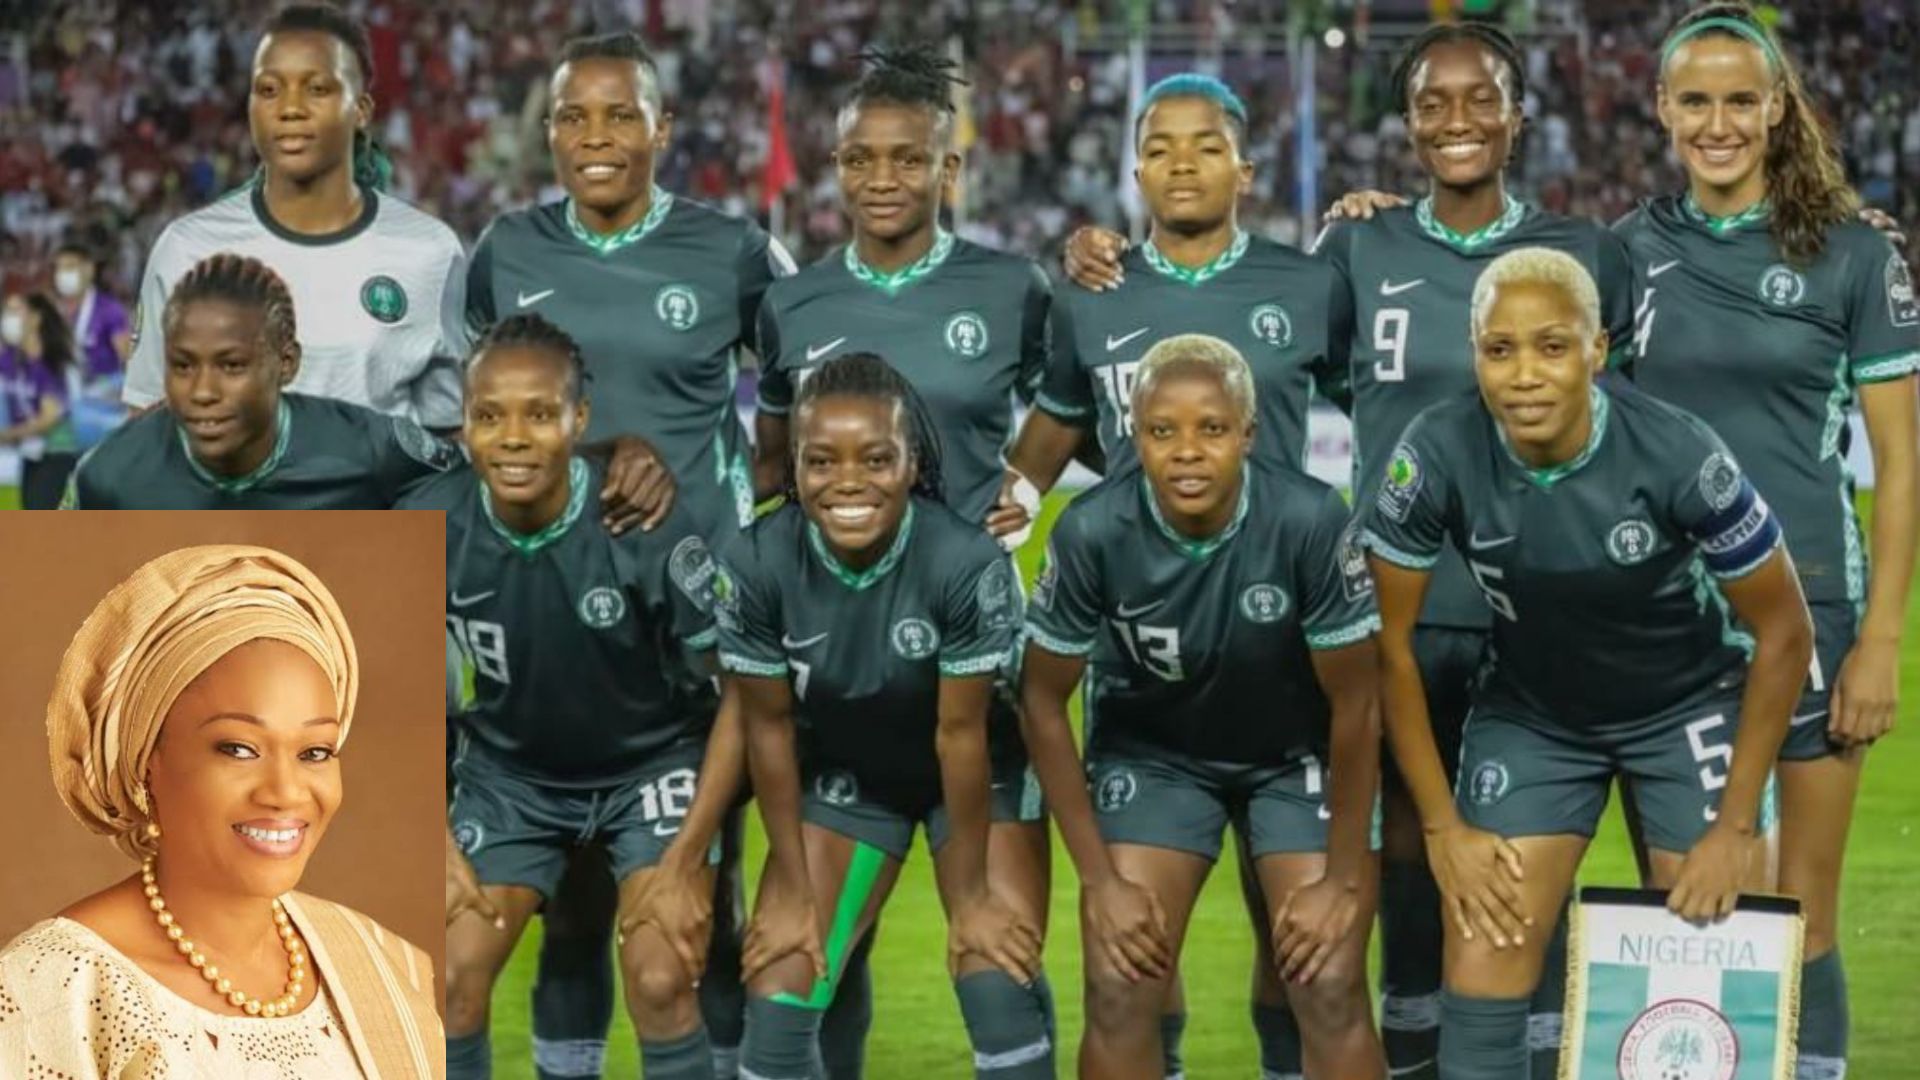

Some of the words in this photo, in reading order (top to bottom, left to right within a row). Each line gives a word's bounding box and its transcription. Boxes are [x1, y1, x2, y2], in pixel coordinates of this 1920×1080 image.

[1373, 308, 1410, 382] 9
[1111, 619, 1184, 681] 13
[1685, 712, 1733, 792] 5
[639, 768, 697, 821] 18
[1618, 932, 1757, 967] NIGERIA
